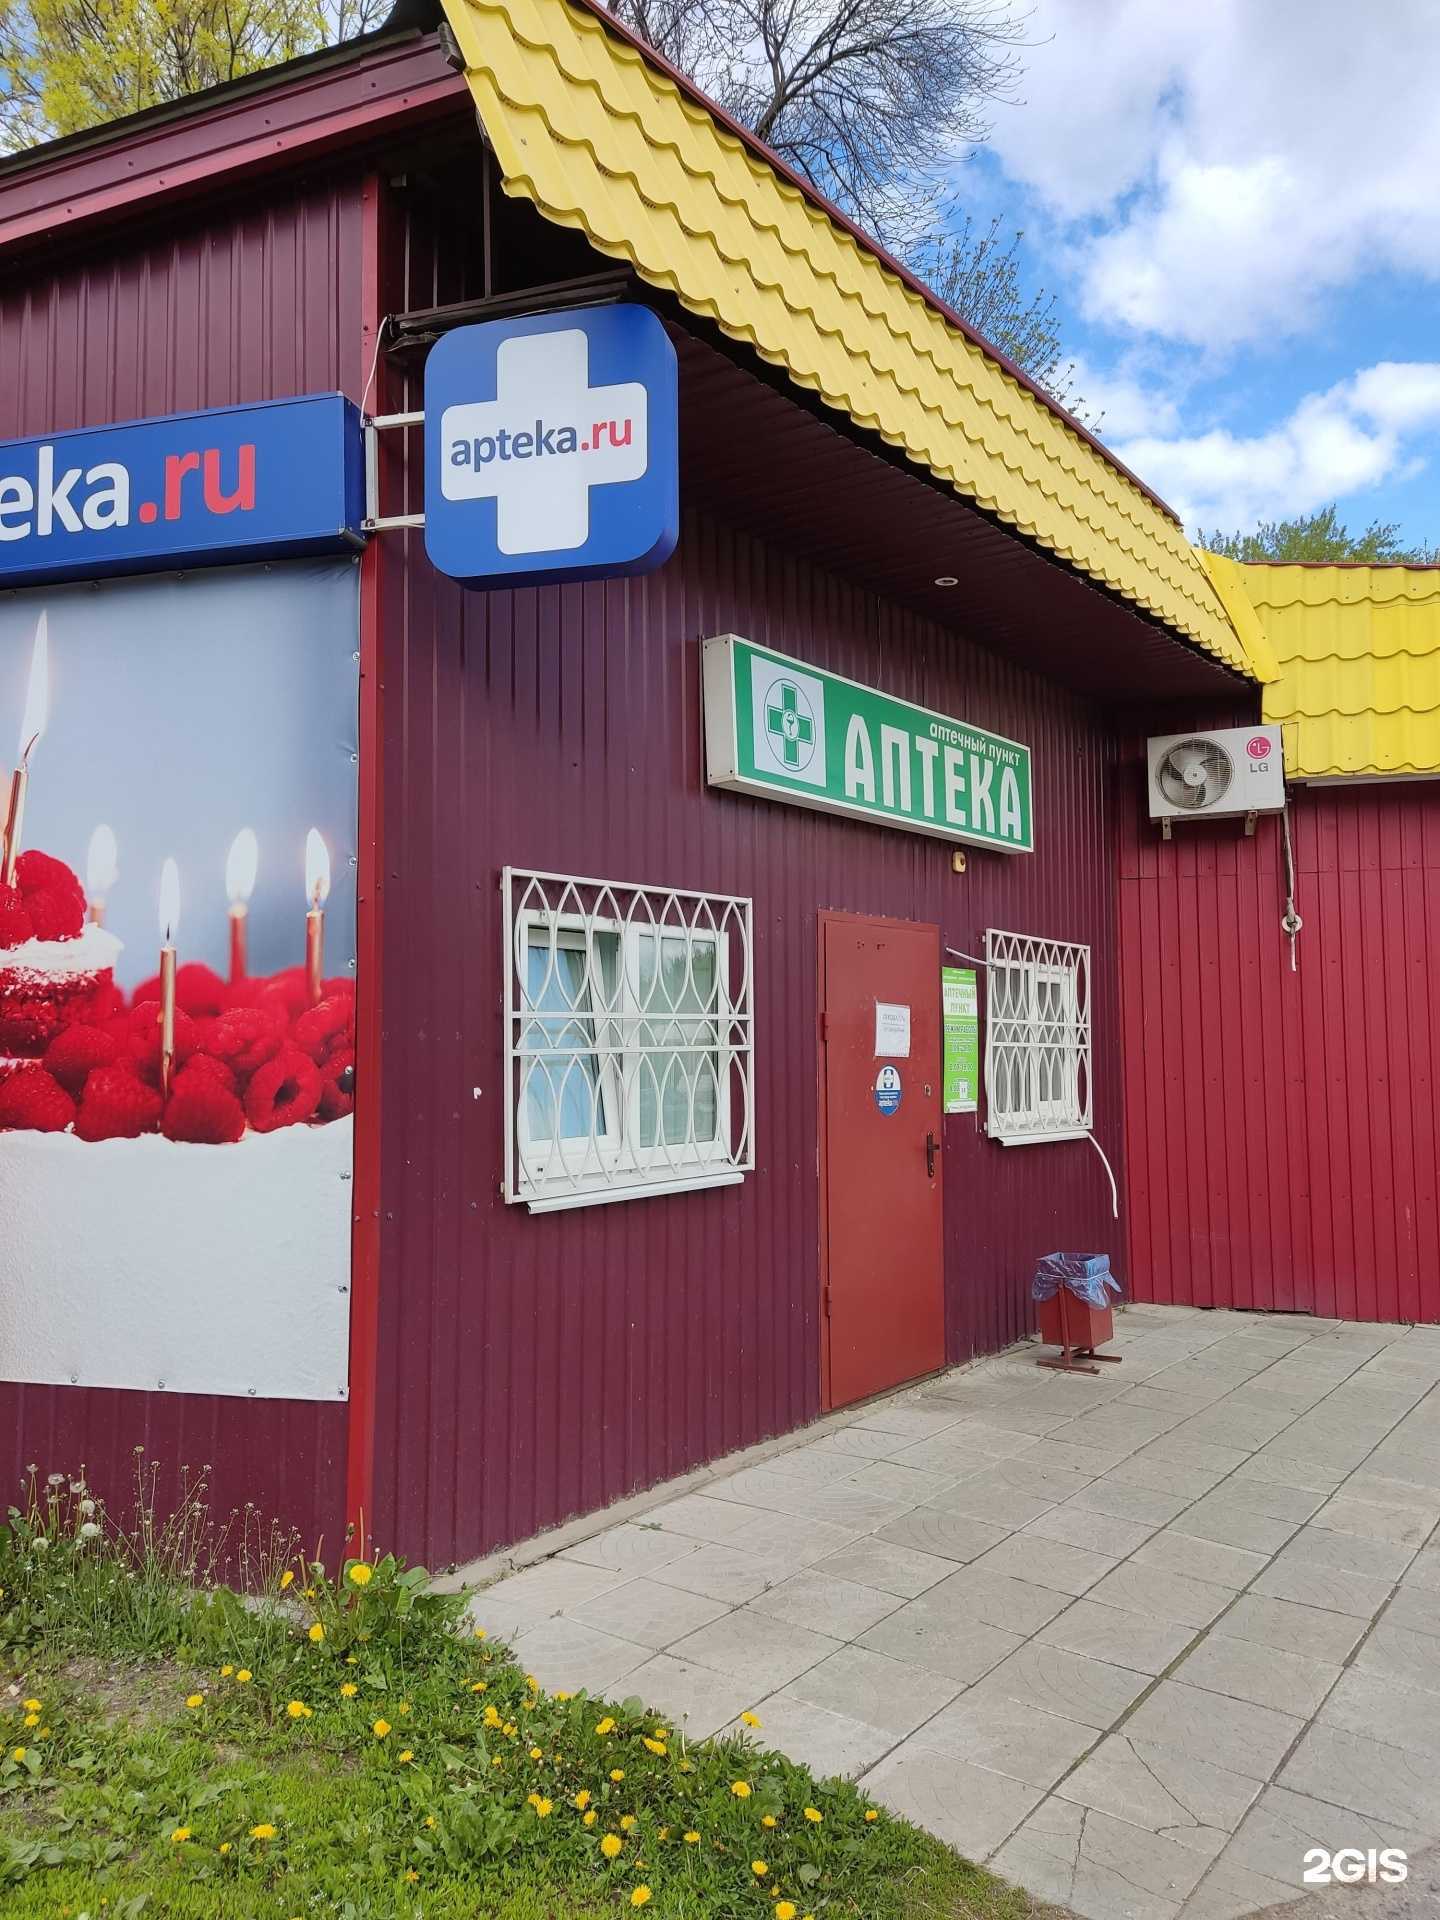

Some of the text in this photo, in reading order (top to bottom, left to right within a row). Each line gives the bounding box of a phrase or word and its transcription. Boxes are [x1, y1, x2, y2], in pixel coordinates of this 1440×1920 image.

[450, 419, 632, 473] apteka.ru
[0, 444, 257, 541] eka.ru
[929, 722, 1021, 767] аптечный пункт
[1249, 762, 1270, 773] LG
[844, 713, 1022, 841] АПТЕКА
